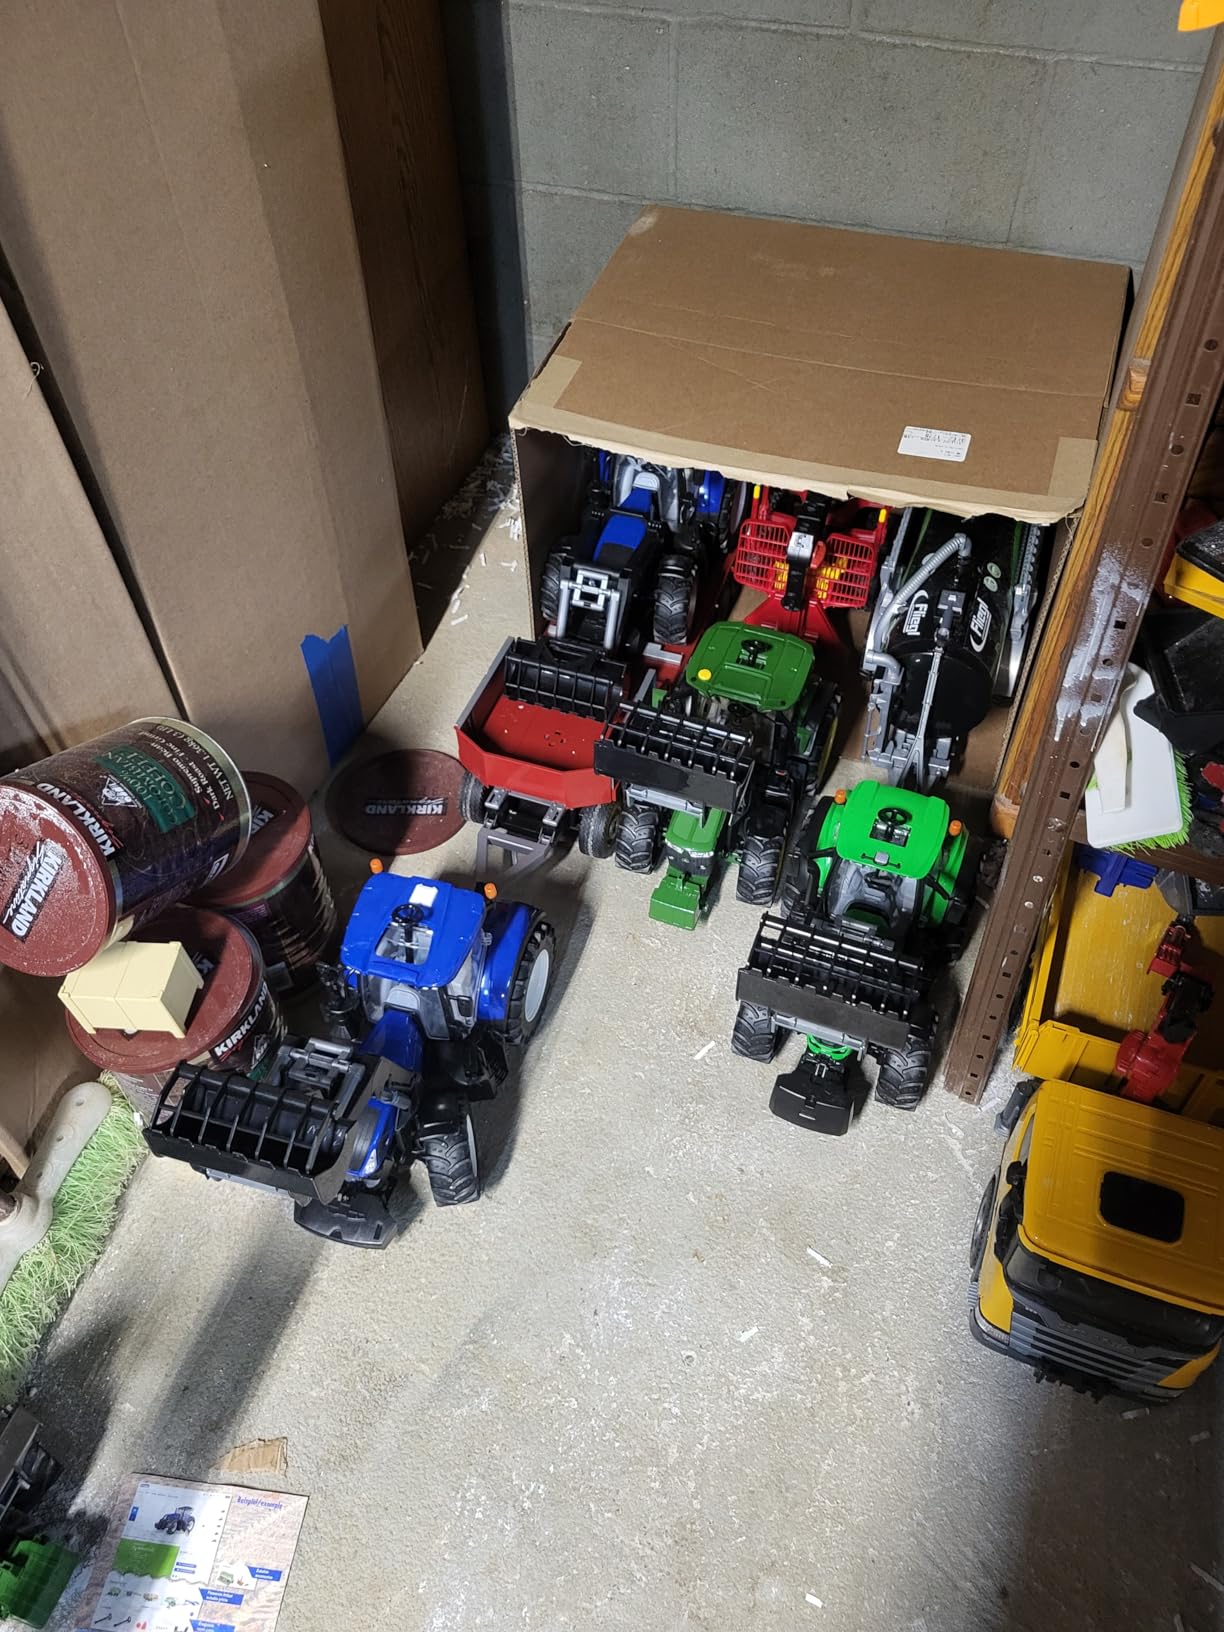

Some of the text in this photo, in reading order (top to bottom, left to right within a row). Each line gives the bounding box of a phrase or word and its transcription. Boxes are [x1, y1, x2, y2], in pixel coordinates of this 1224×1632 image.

[905, 603, 929, 636] Fliegl
[970, 597, 989, 637] Fliegl
[165, 740, 185, 758] Fine
[119, 768, 153, 801] 100%
[151, 741, 201, 795] Supremo Bean
[189, 760, 208, 786] Roast
[207, 761, 222, 780] WT
[206, 786, 220, 810] Dark
[219, 779, 234, 801] NET
[36, 782, 116, 857] KIRKLAND
[365, 804, 443, 815] KIRKLAND
[2, 840, 45, 924] Signature
[11, 850, 63, 937] KIRKLAND
[214, 981, 268, 1057] KIRKLAND
